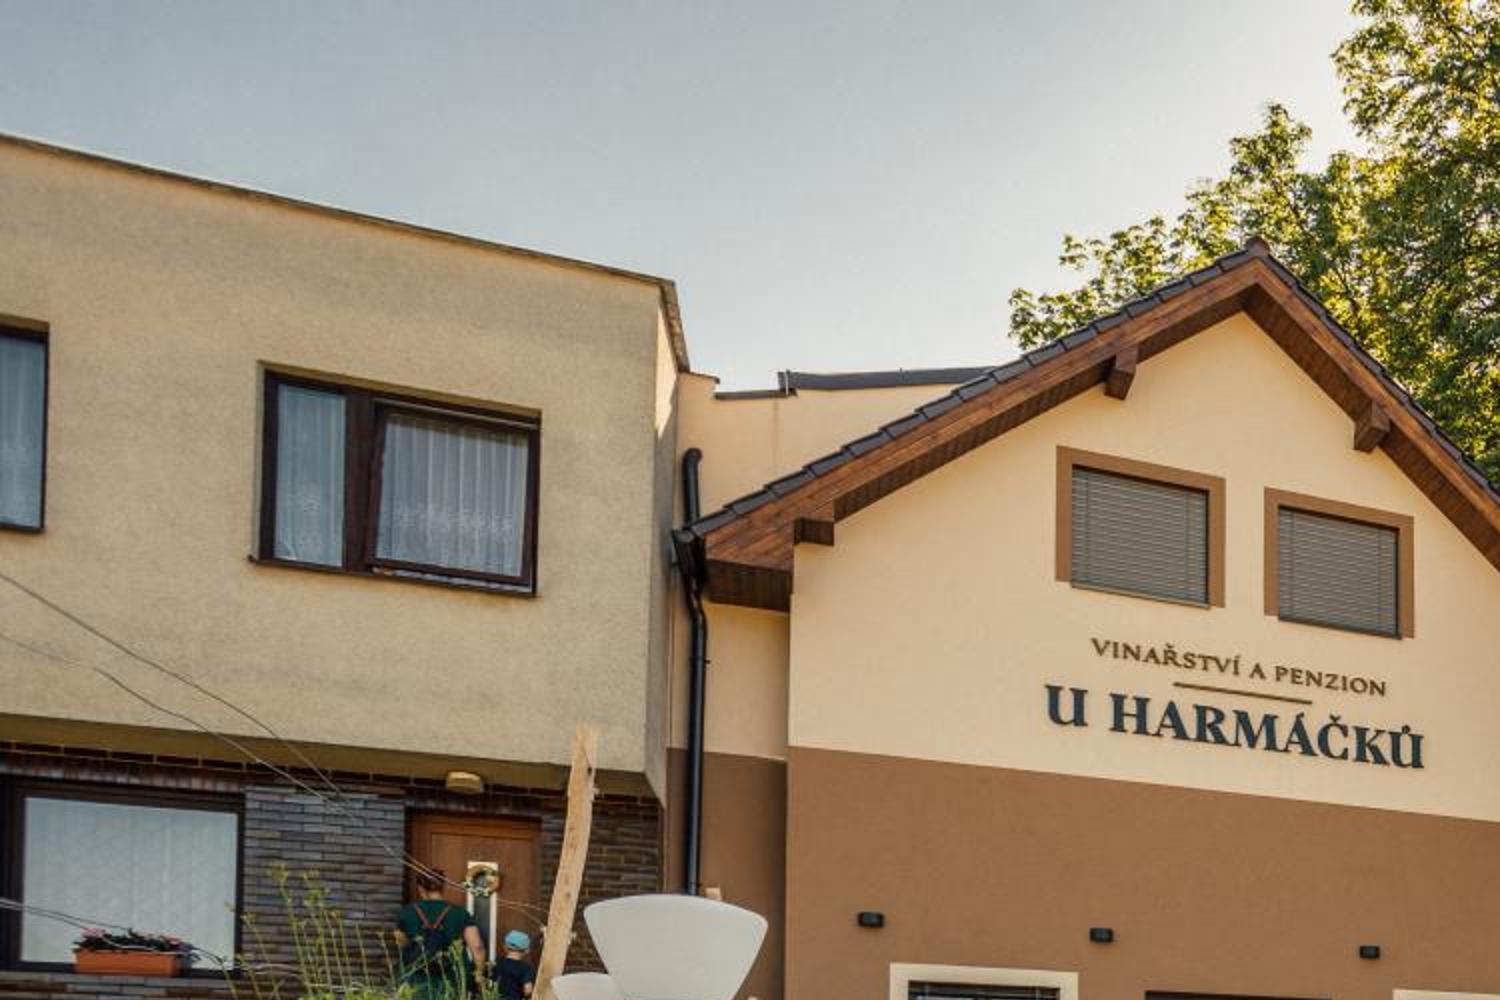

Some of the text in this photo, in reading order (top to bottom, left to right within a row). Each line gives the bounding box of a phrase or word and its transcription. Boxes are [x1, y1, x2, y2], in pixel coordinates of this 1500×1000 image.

[1090, 637, 1387, 697] VINAŘSTVÍ A PENZION
[1044, 684, 1425, 769] U HARMÁČKŮ
